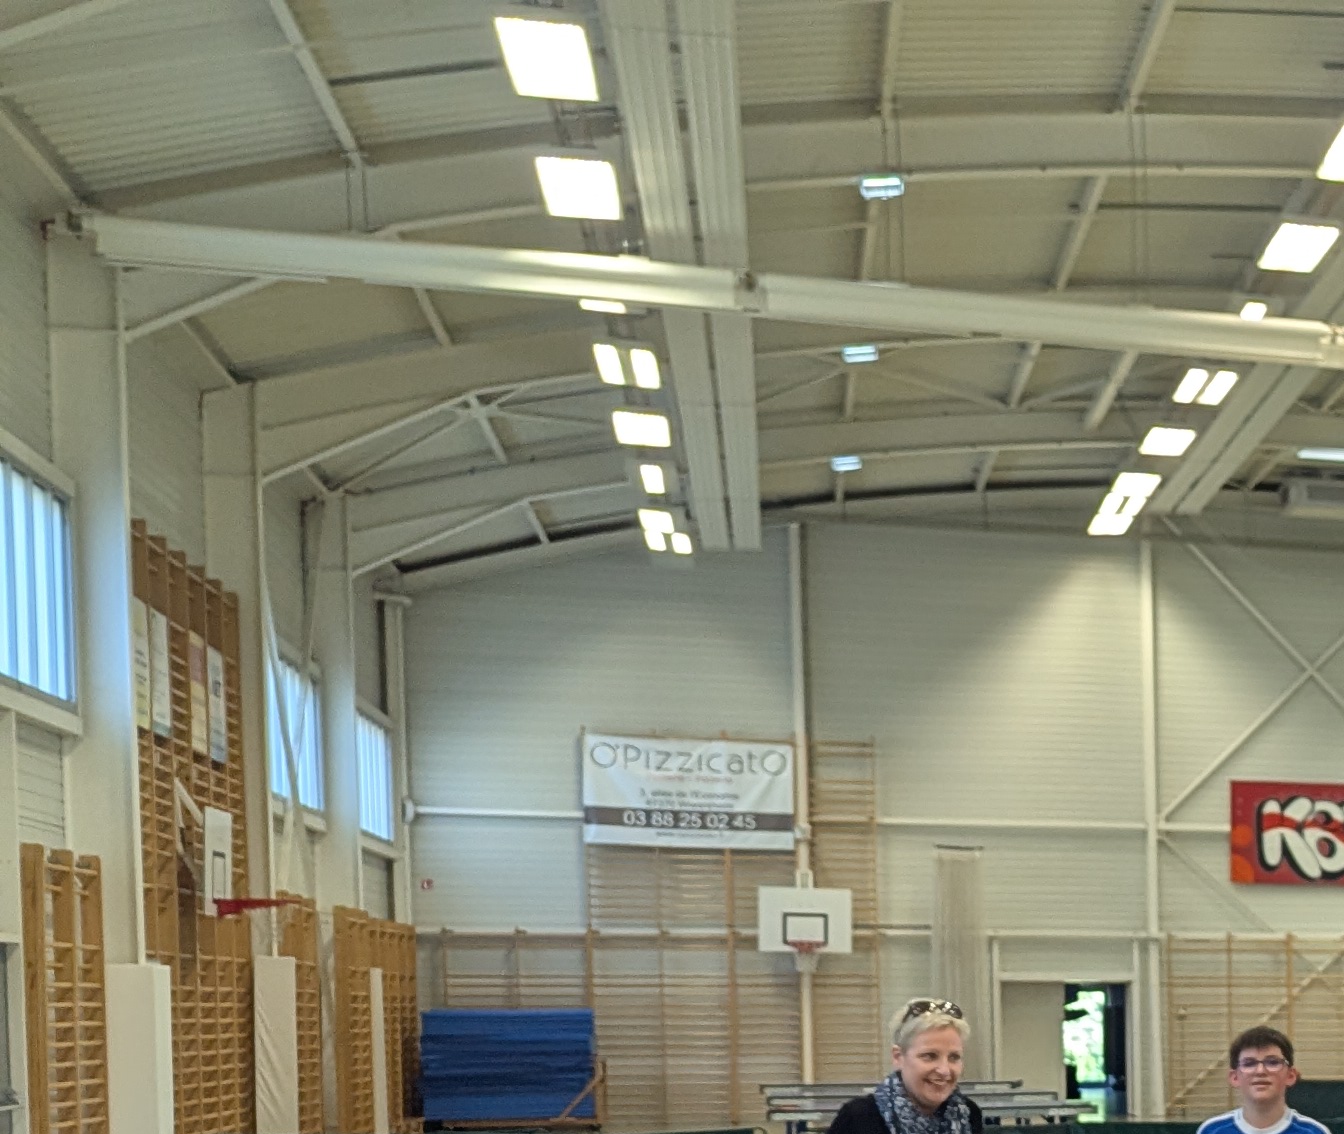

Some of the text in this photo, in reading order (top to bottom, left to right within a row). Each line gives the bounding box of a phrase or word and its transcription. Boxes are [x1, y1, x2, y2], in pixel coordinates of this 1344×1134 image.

[623, 810, 756, 830] 03 88 25 02 45
